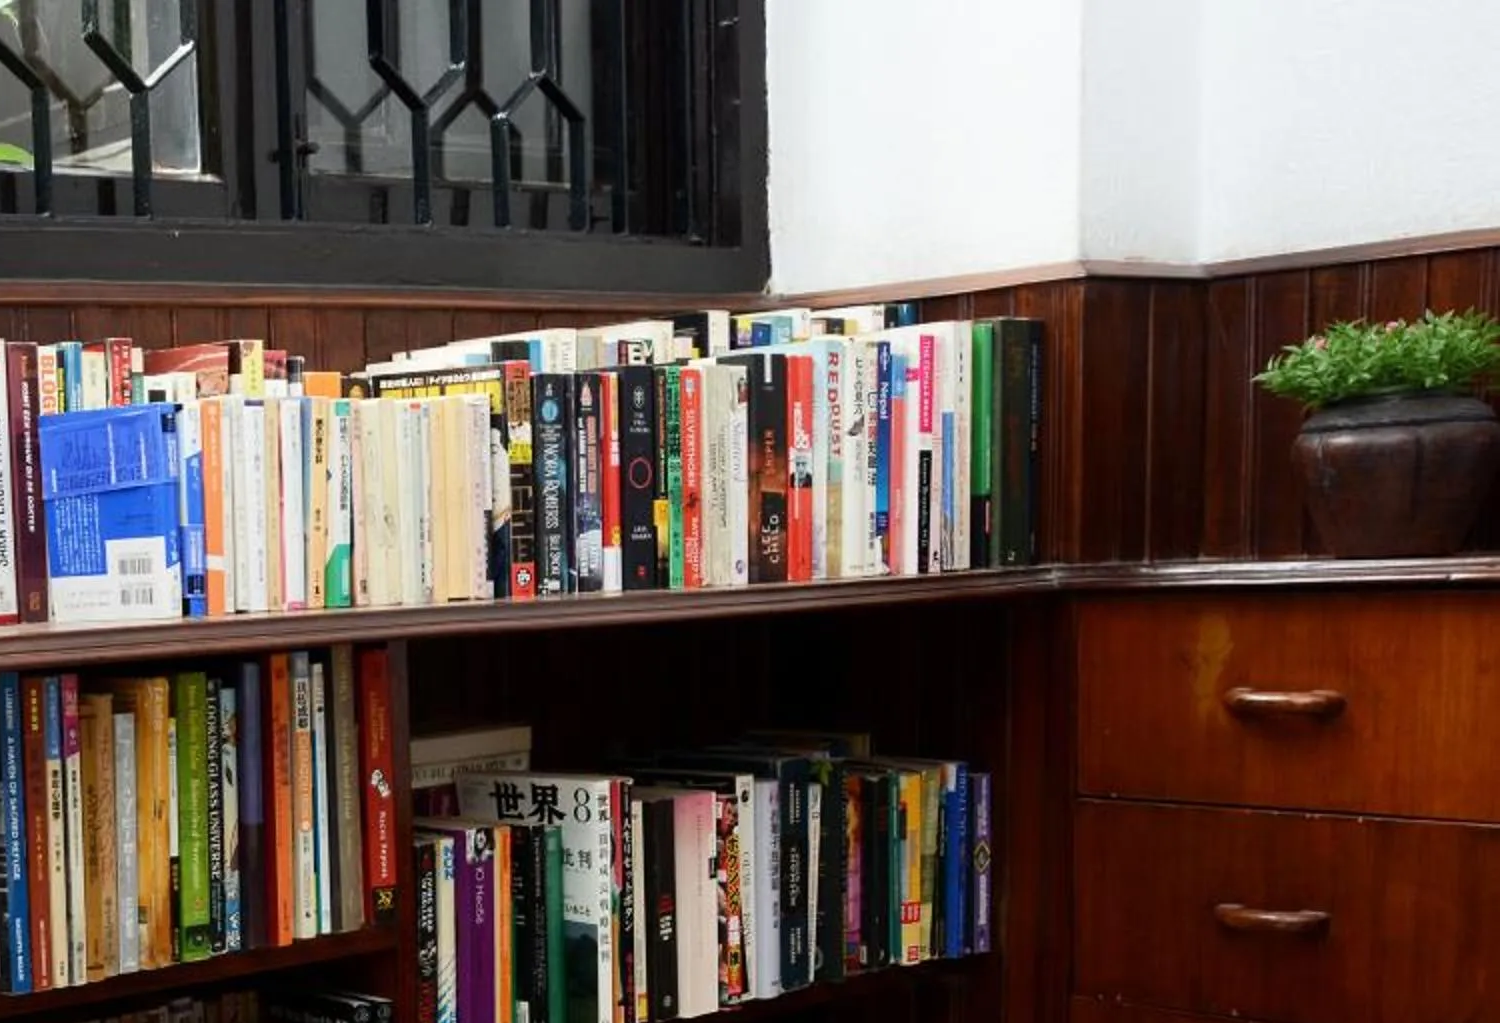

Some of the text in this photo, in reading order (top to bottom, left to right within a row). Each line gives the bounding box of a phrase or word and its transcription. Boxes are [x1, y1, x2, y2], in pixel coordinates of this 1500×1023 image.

[41, 355, 57, 413] BLOG
[827, 352, 842, 457] RED DUST
[878, 382, 888, 419] Nepal
[543, 443, 560, 529] NORA ROBERTS
[6, 744, 17, 780] HAVEN
[8, 781, 18, 795] OF
[205, 696, 222, 882] LOOKING GLASS UNIVERSE
[488, 780, 593, 826] 世界 8
[9, 797, 20, 839] SACRED
